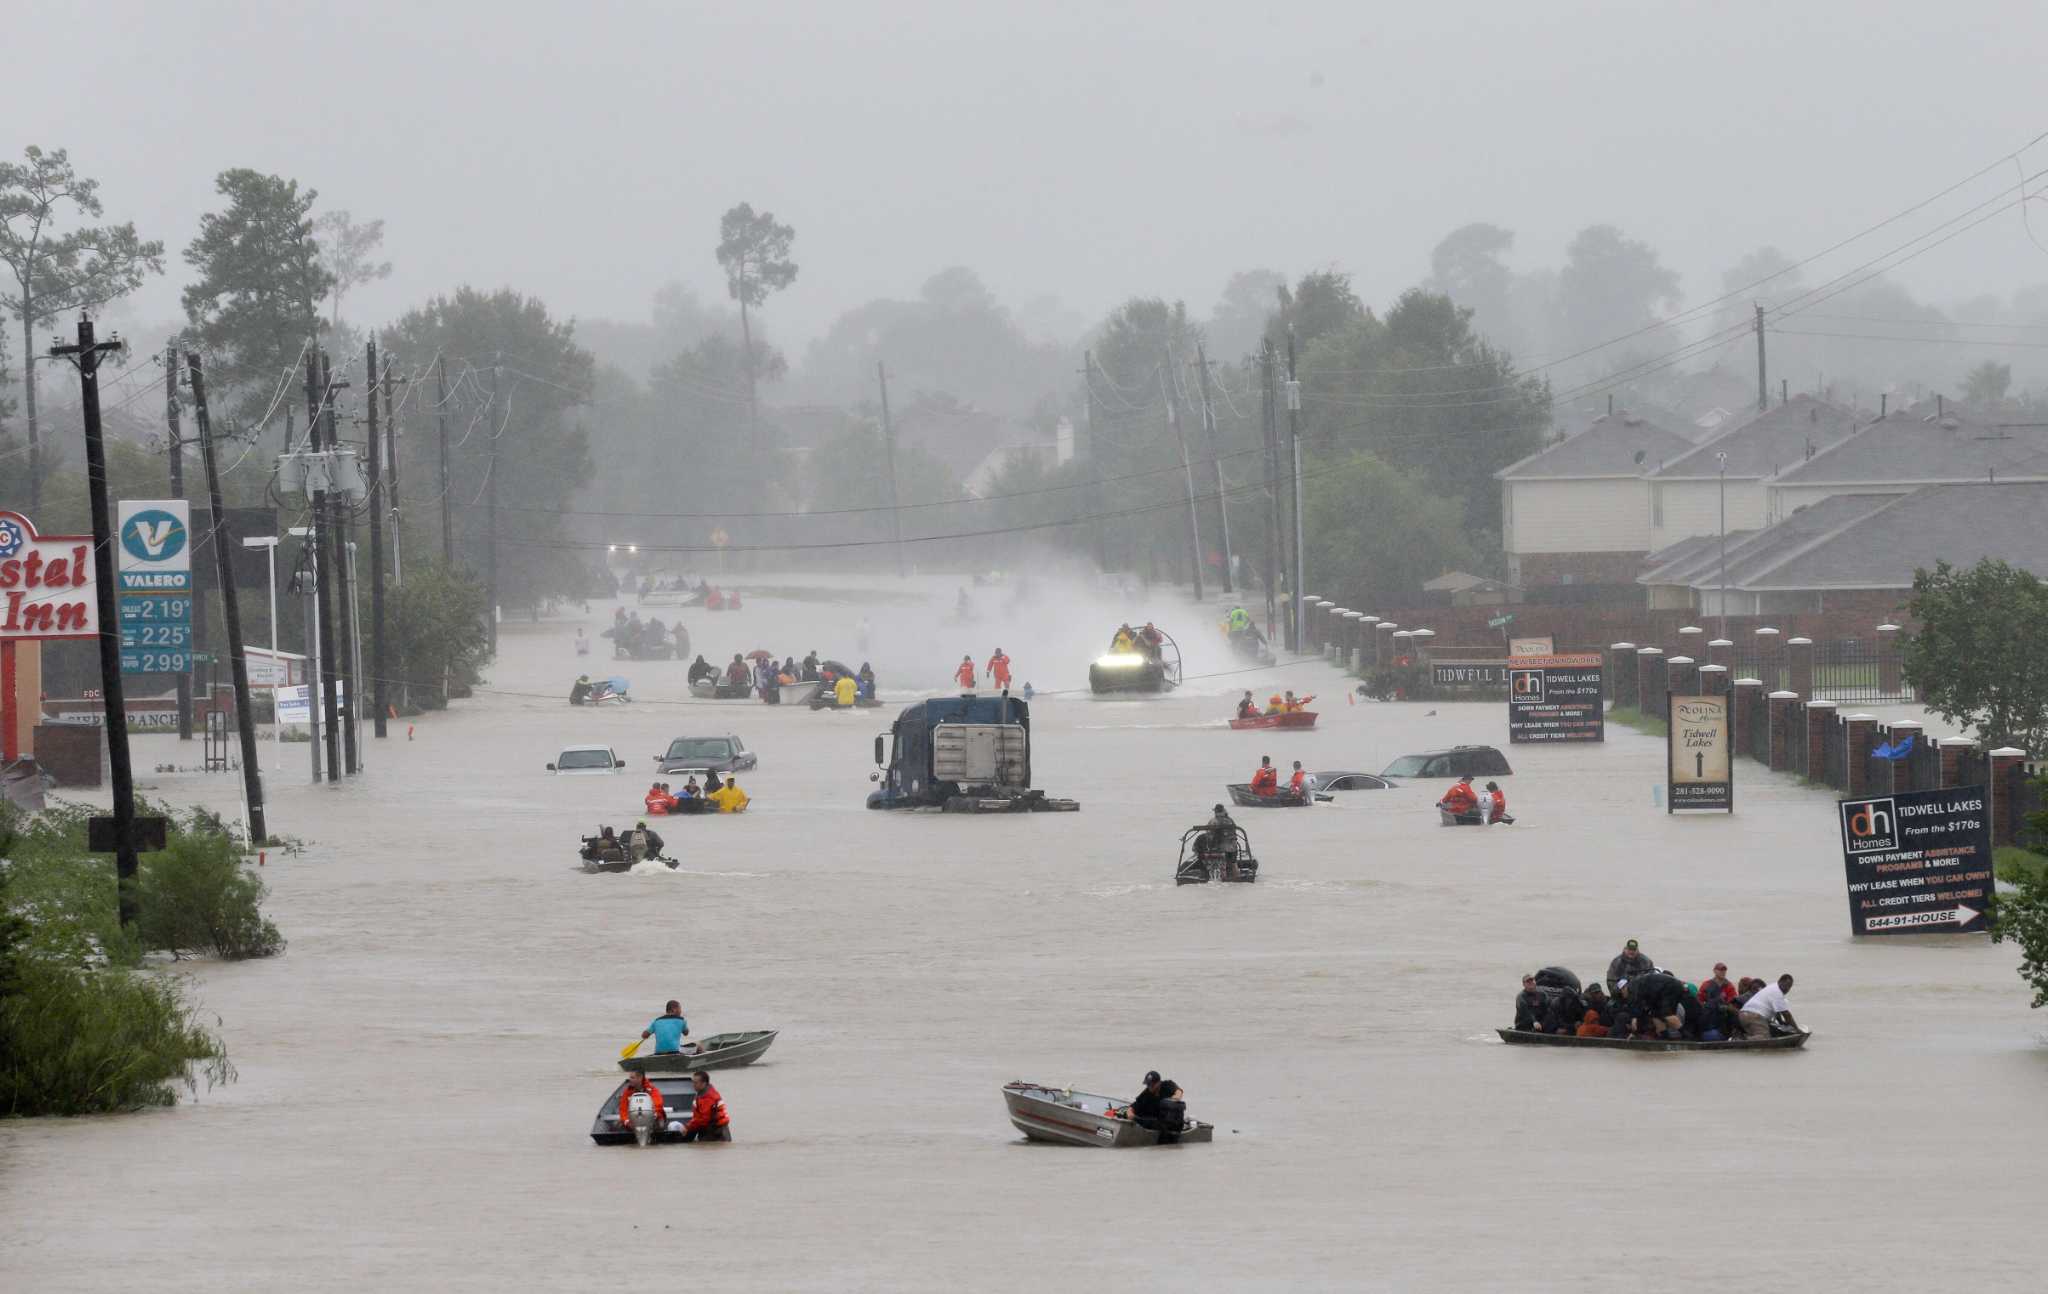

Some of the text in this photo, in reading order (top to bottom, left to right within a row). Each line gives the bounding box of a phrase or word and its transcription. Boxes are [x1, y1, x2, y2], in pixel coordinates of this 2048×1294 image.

[124, 574, 186, 586] VALERO
[1, 591, 88, 631] Inn
[1546, 674, 1600, 683] TIDWELL LAKES
[84, 690, 100, 698] FDC
[1683, 728, 1716, 738] Tidwell
[1686, 738, 1712, 748] Lakes
[1899, 800, 1982, 817] TIDWELL LAKES
[1905, 820, 1981, 836] From the $170s
[1853, 838, 1892, 850] Homes
[1858, 855, 1884, 864] DOWN
[1886, 851, 1924, 862] PAYMENT
[1924, 860, 1931, 868] &
[1933, 857, 1960, 868] MORE!
[1849, 882, 1869, 892] WHY
[1870, 880, 1898, 890] LEASE
[1899, 877, 1924, 888] WHEN
[1861, 898, 1878, 908] ALL
[1879, 896, 1910, 906] CREDIT
[1911, 893, 1936, 904] TIERS
[1869, 911, 1956, 928] 844-91-HOUSE
